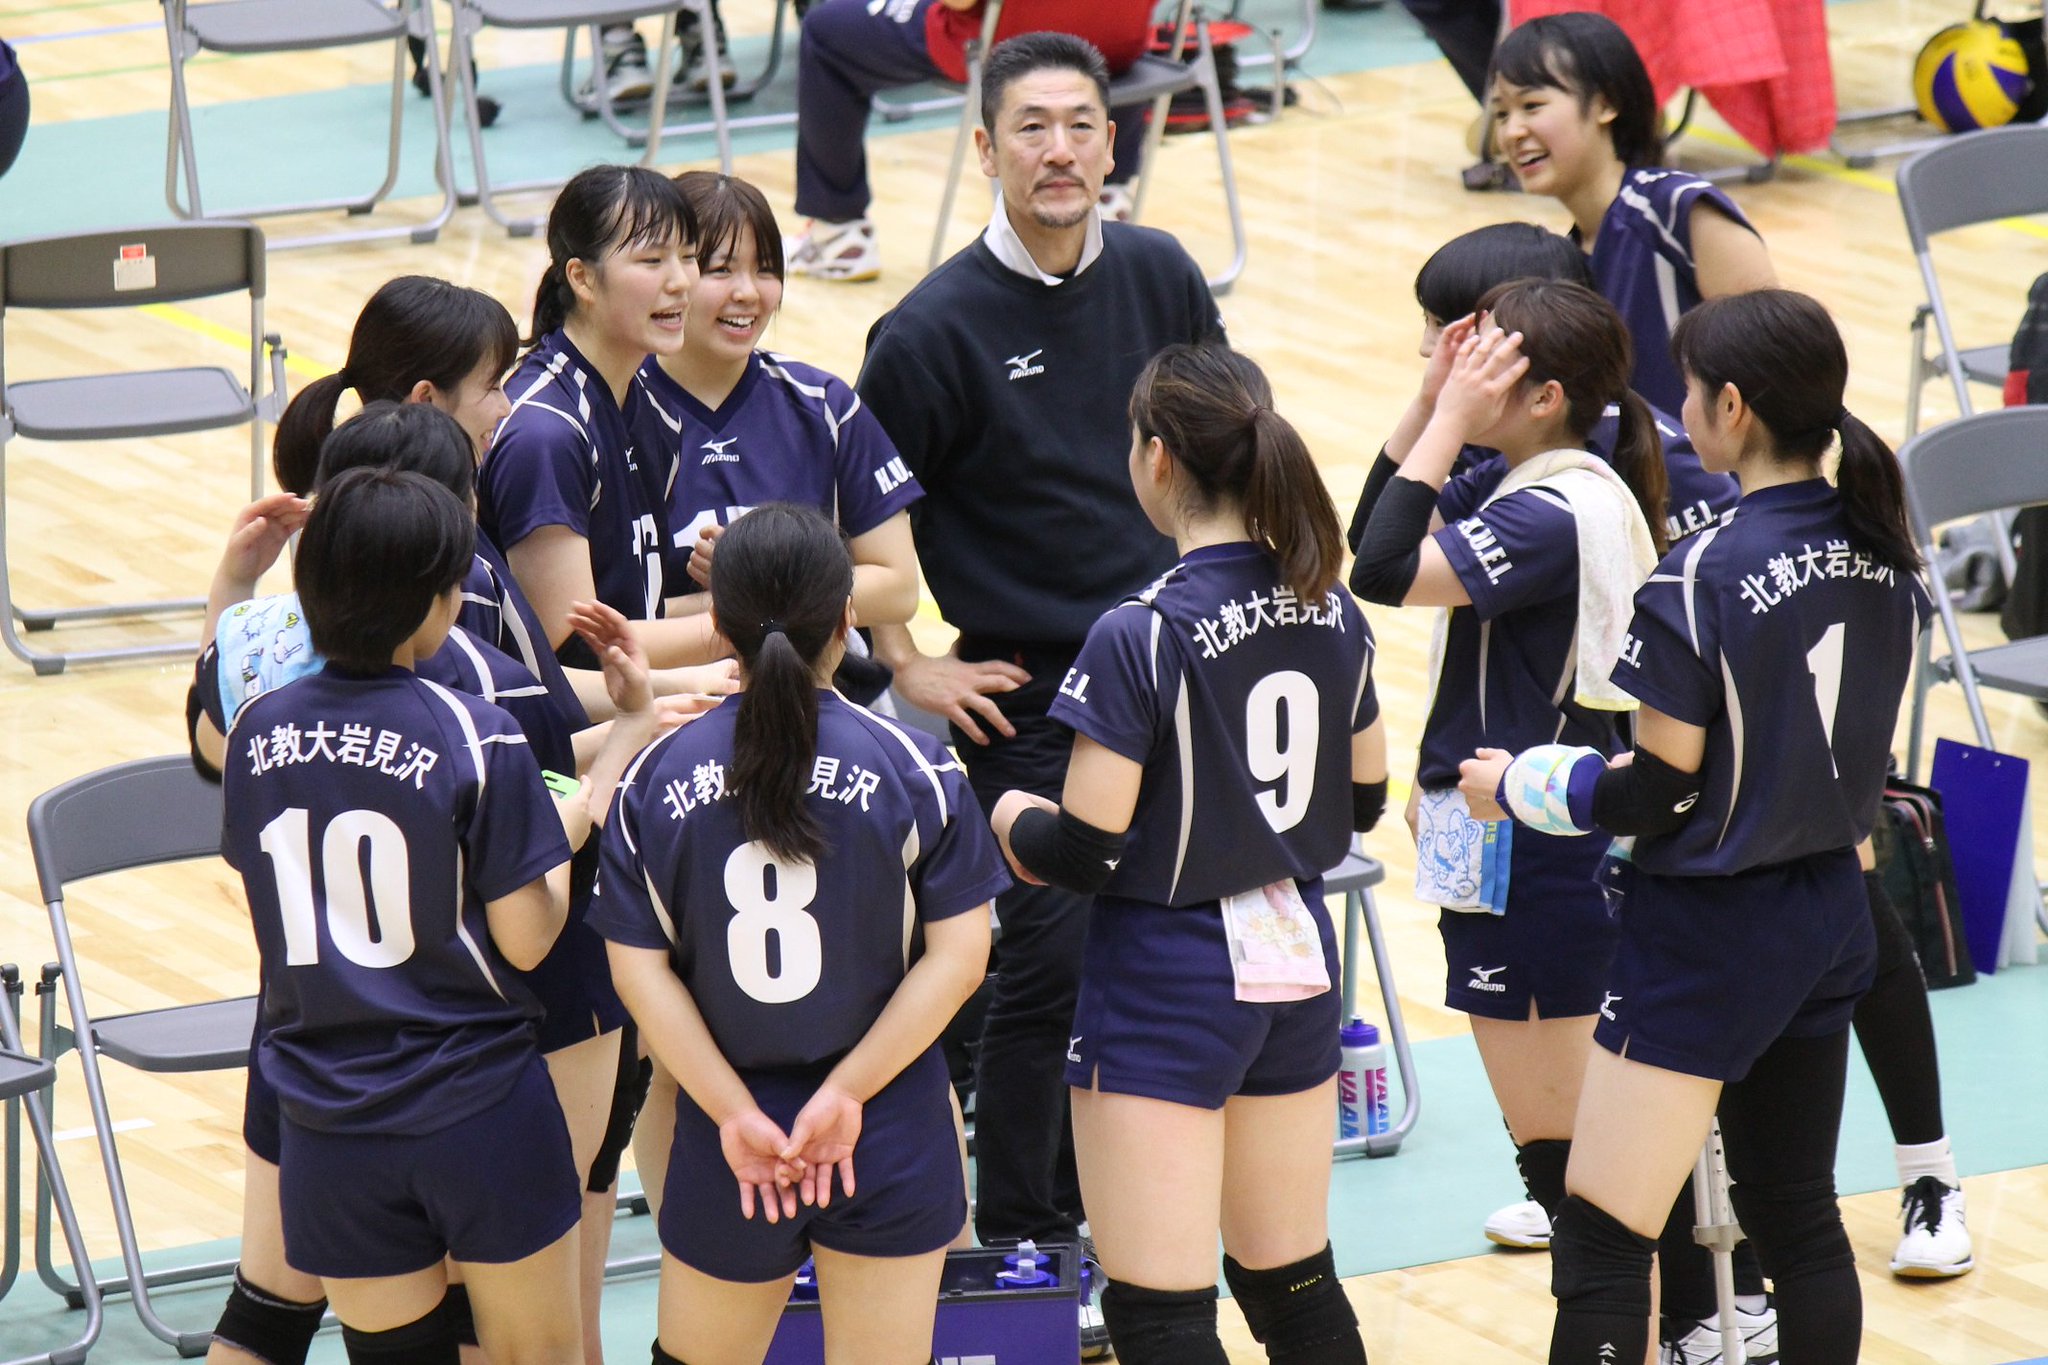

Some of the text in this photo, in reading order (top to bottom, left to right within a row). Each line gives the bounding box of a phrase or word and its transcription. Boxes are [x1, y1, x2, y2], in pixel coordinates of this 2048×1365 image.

[246, 720, 439, 790] 北教大岩見沢
[1246, 669, 1320, 834] 9
[1806, 621, 1846, 780] 1
[662, 755, 881, 821] 北教見沢
[259, 807, 416, 969] 10
[723, 838, 823, 1004] 8
